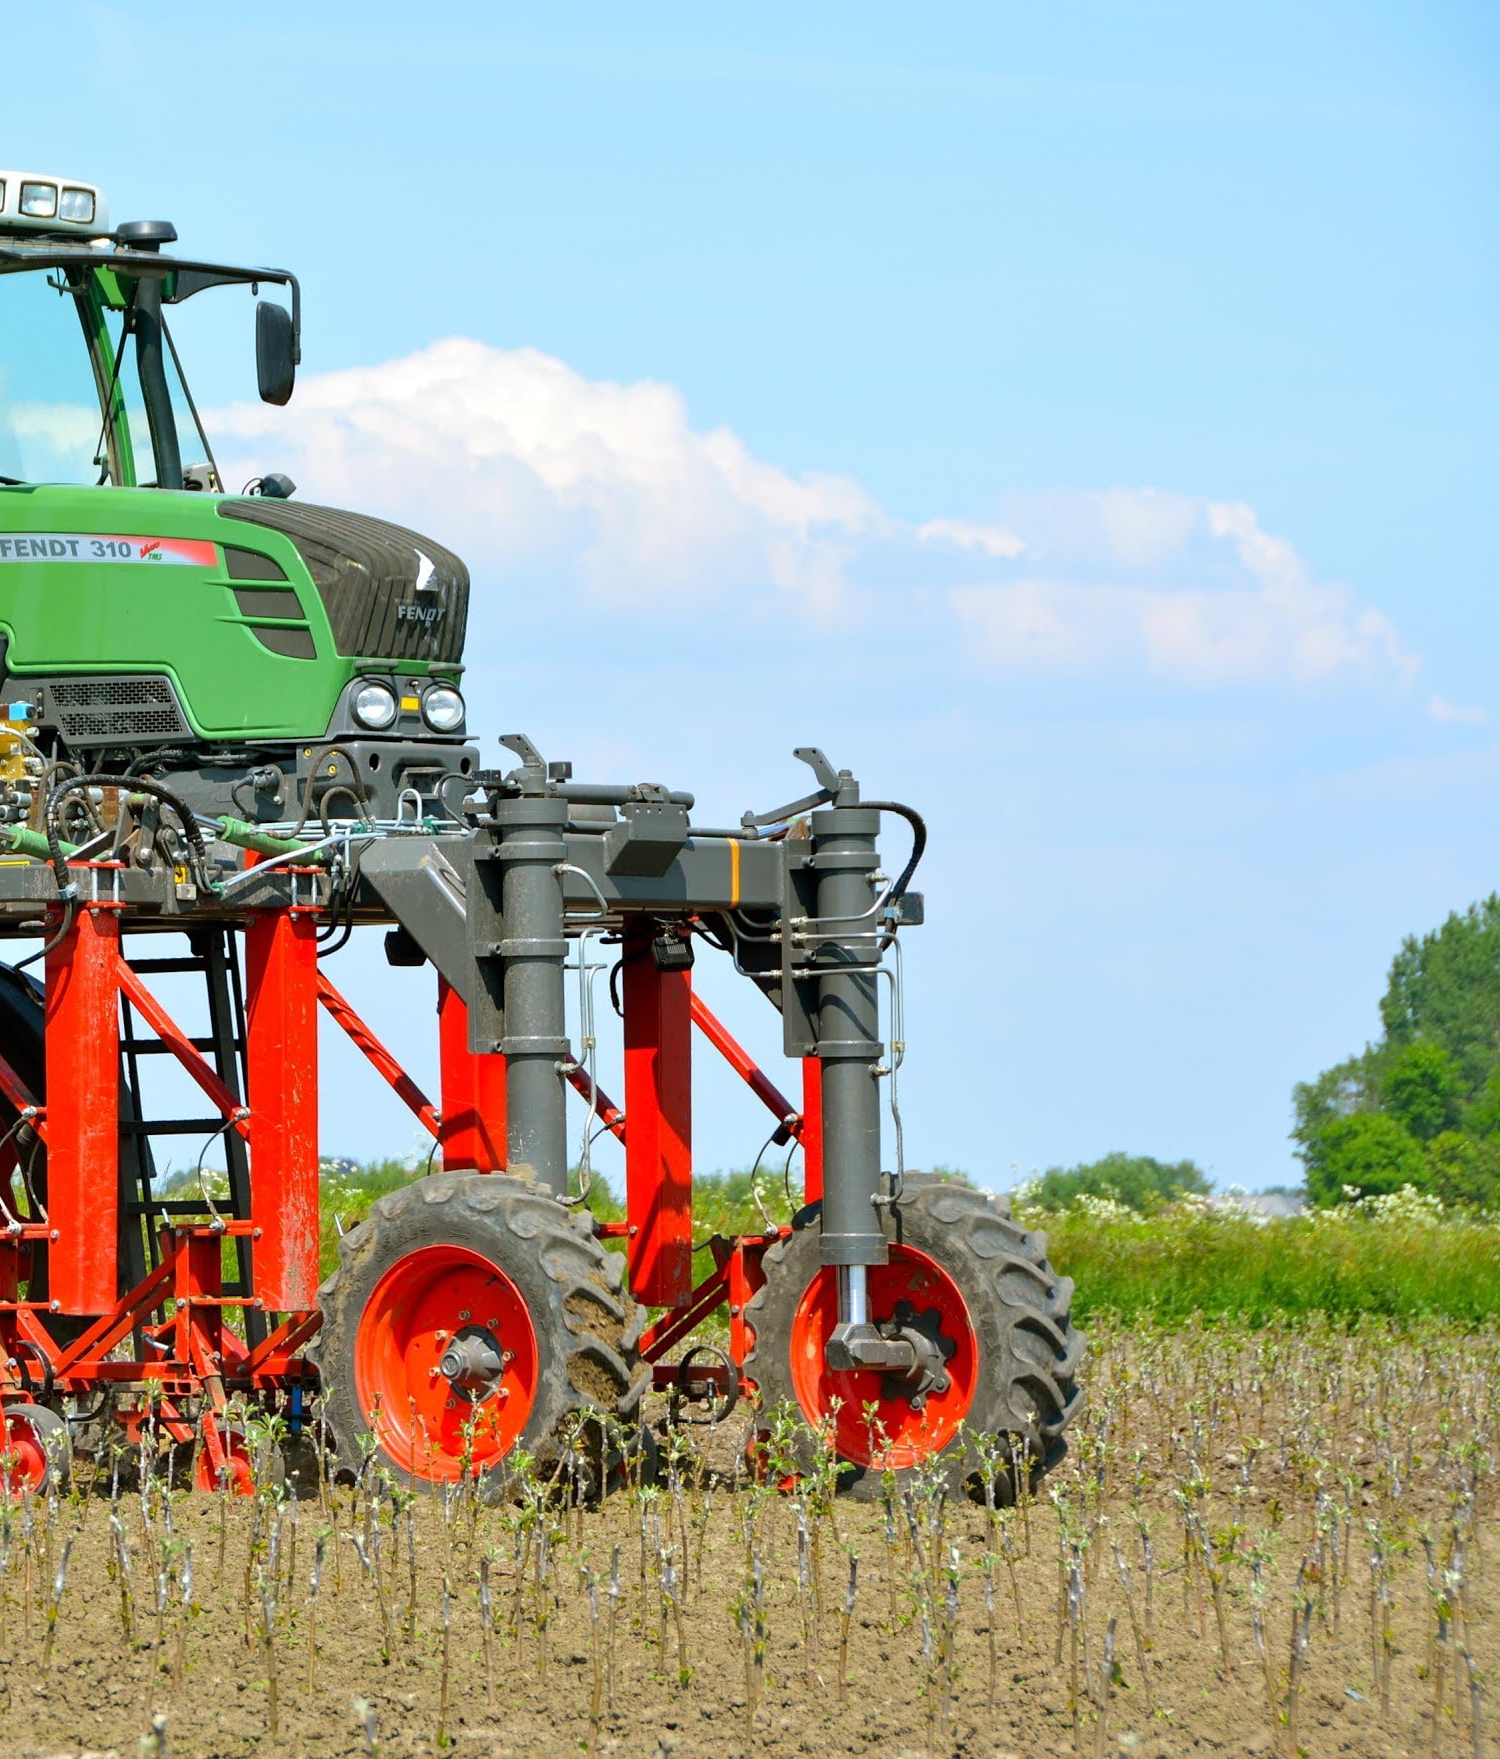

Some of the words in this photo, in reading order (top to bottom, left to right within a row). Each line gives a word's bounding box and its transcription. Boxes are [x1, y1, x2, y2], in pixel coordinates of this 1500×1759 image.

[0, 538, 79, 558] FENDT
[89, 539, 132, 558] 310
[397, 604, 446, 622] FENDT
